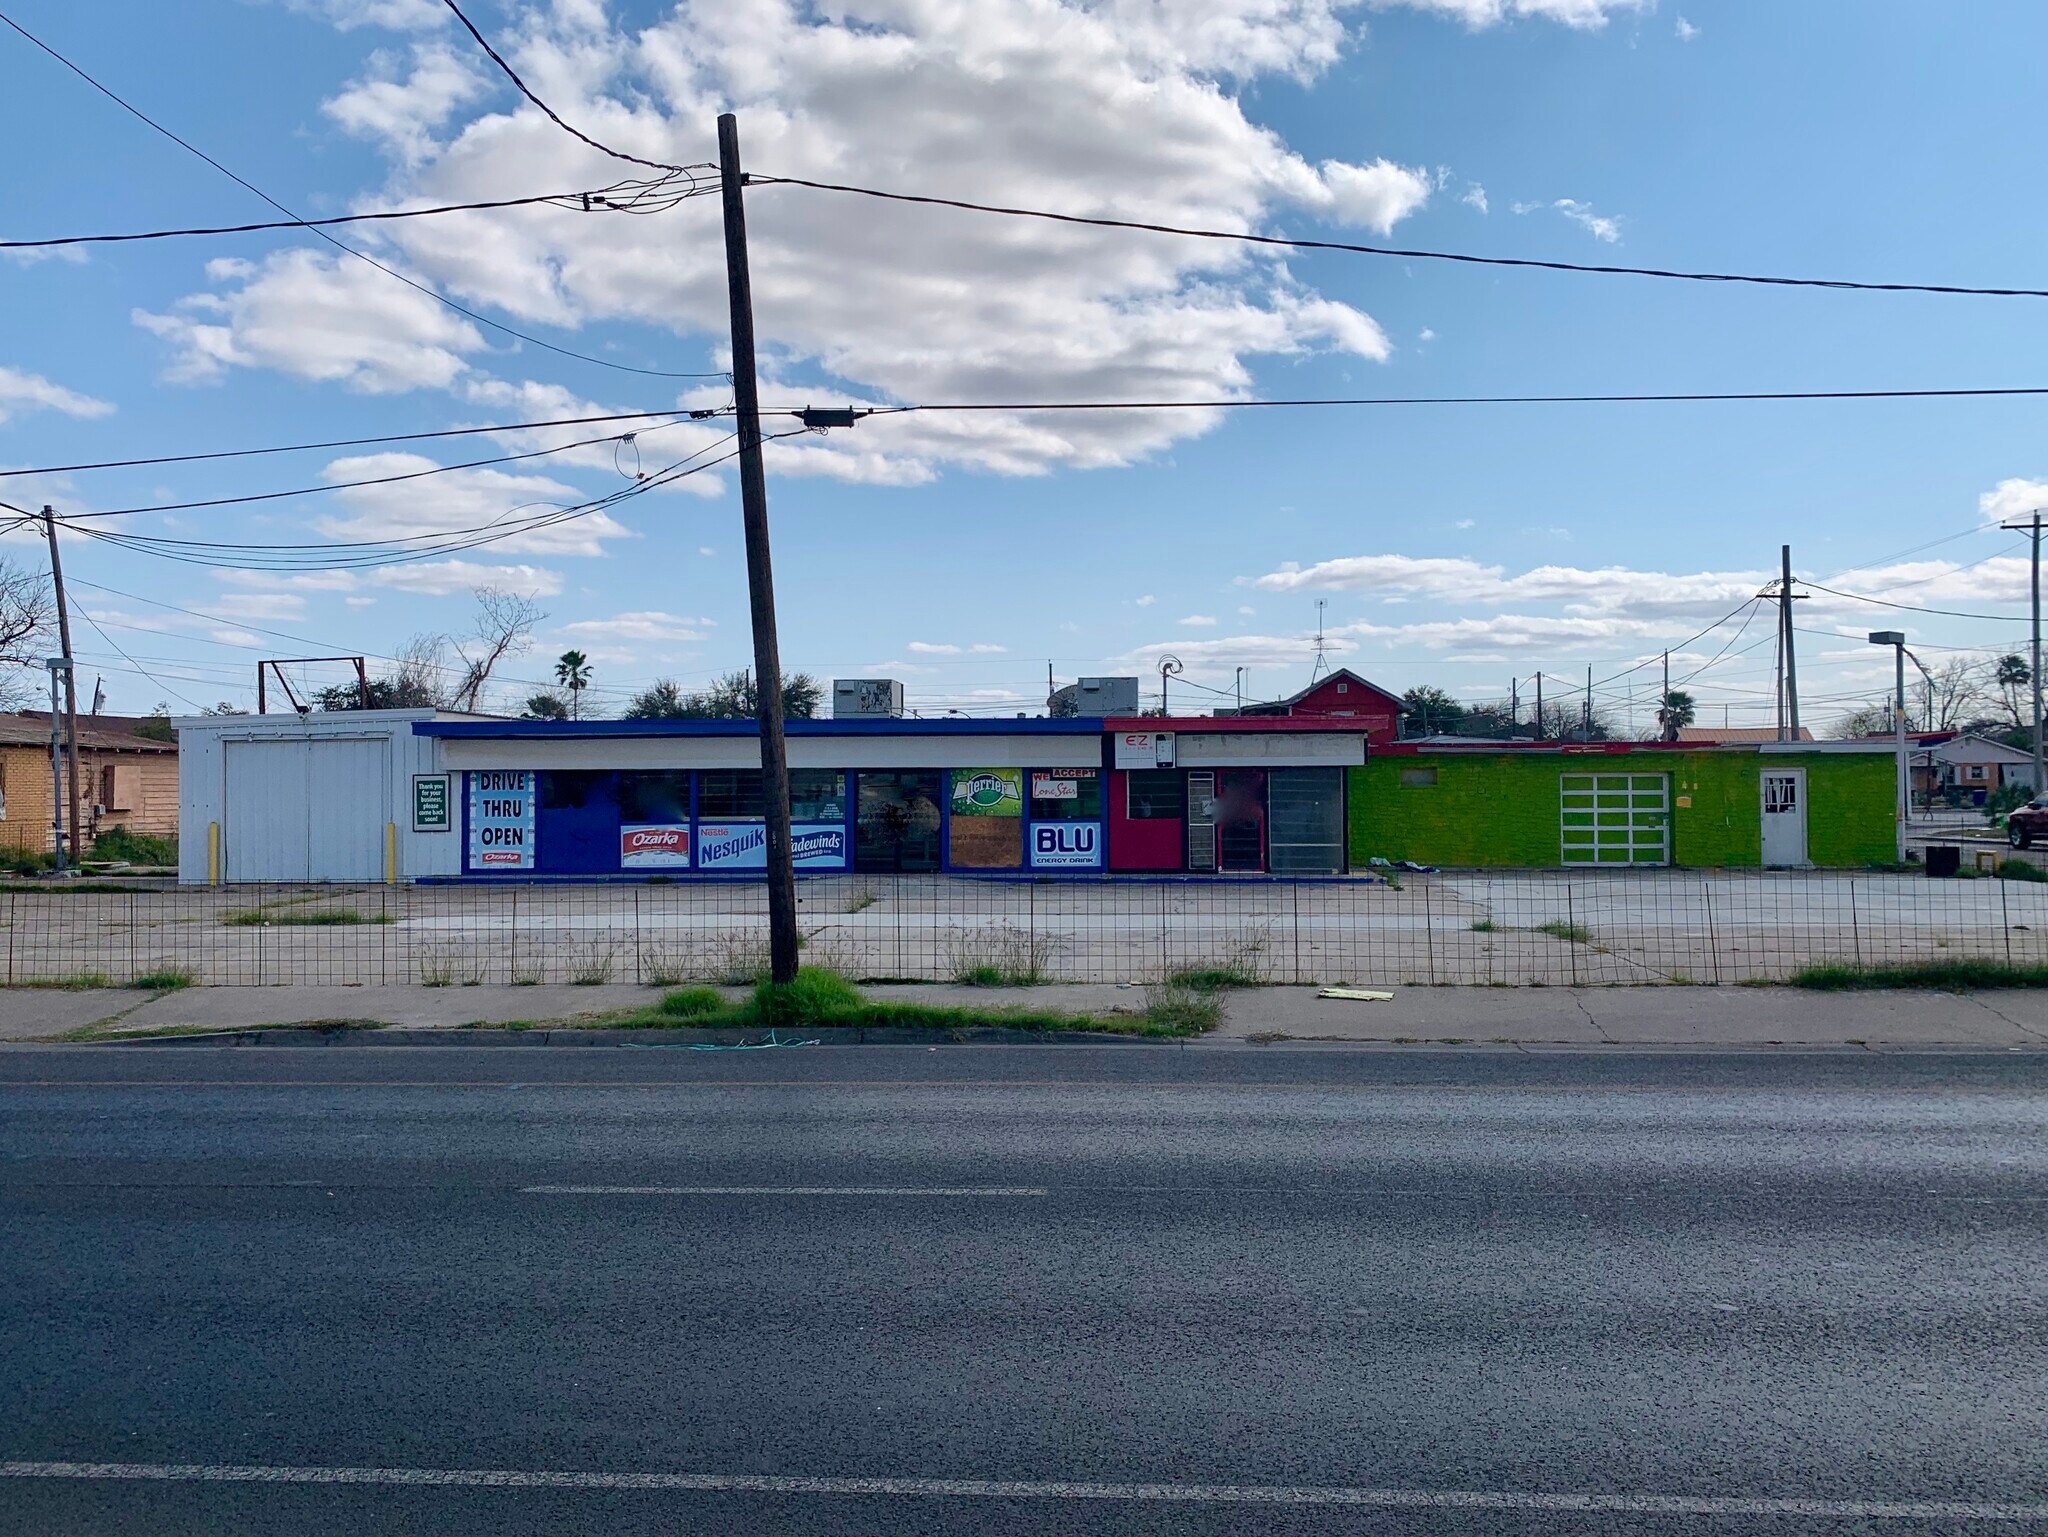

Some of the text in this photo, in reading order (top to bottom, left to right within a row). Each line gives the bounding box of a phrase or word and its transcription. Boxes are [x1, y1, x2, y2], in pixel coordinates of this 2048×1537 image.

[1125, 735, 1148, 746] EZ
[481, 772, 525, 791] DRIVE
[1053, 769, 1095, 777] ACCEPT
[1034, 781, 1076, 797] Lone Star
[482, 799, 522, 817] THRU
[481, 827, 523, 846] OPEN
[632, 832, 679, 846] Ozarka
[791, 833, 841, 853] adewinds
[1036, 827, 1095, 853] BLU
[701, 828, 765, 865] Nesquik
